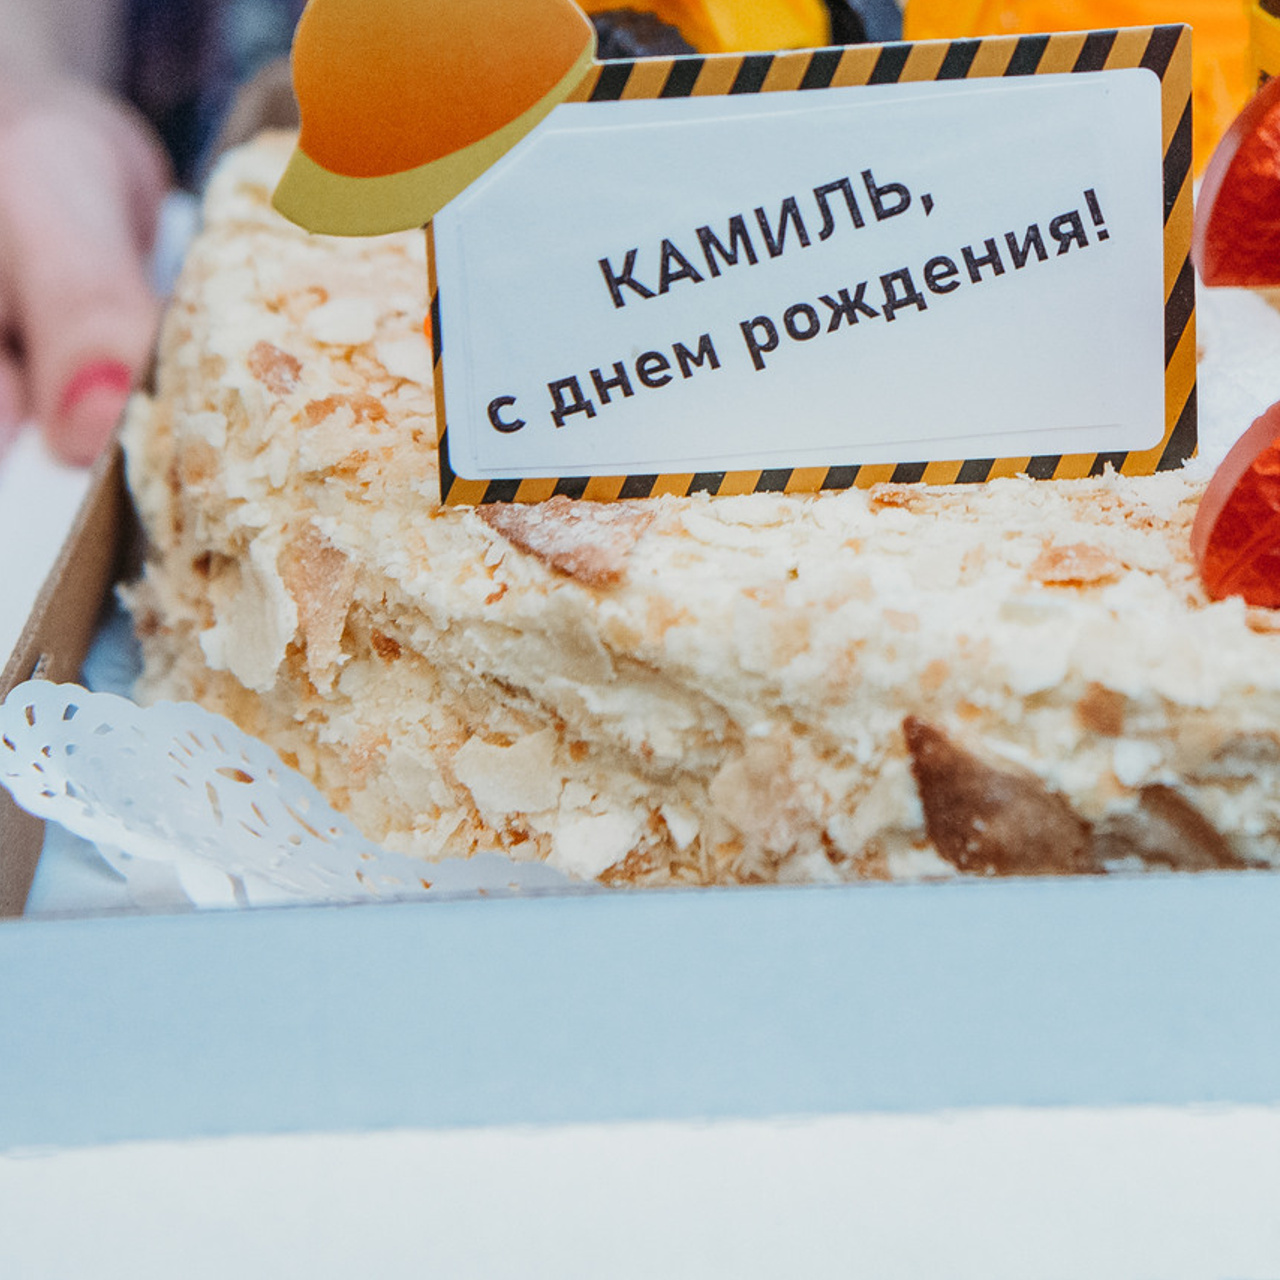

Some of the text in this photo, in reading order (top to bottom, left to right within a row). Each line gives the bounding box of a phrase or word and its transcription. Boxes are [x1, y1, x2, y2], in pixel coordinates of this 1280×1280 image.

[486, 187, 1112, 435] с днем рождения!
[598, 169, 935, 309] КАМИЛЬ,
